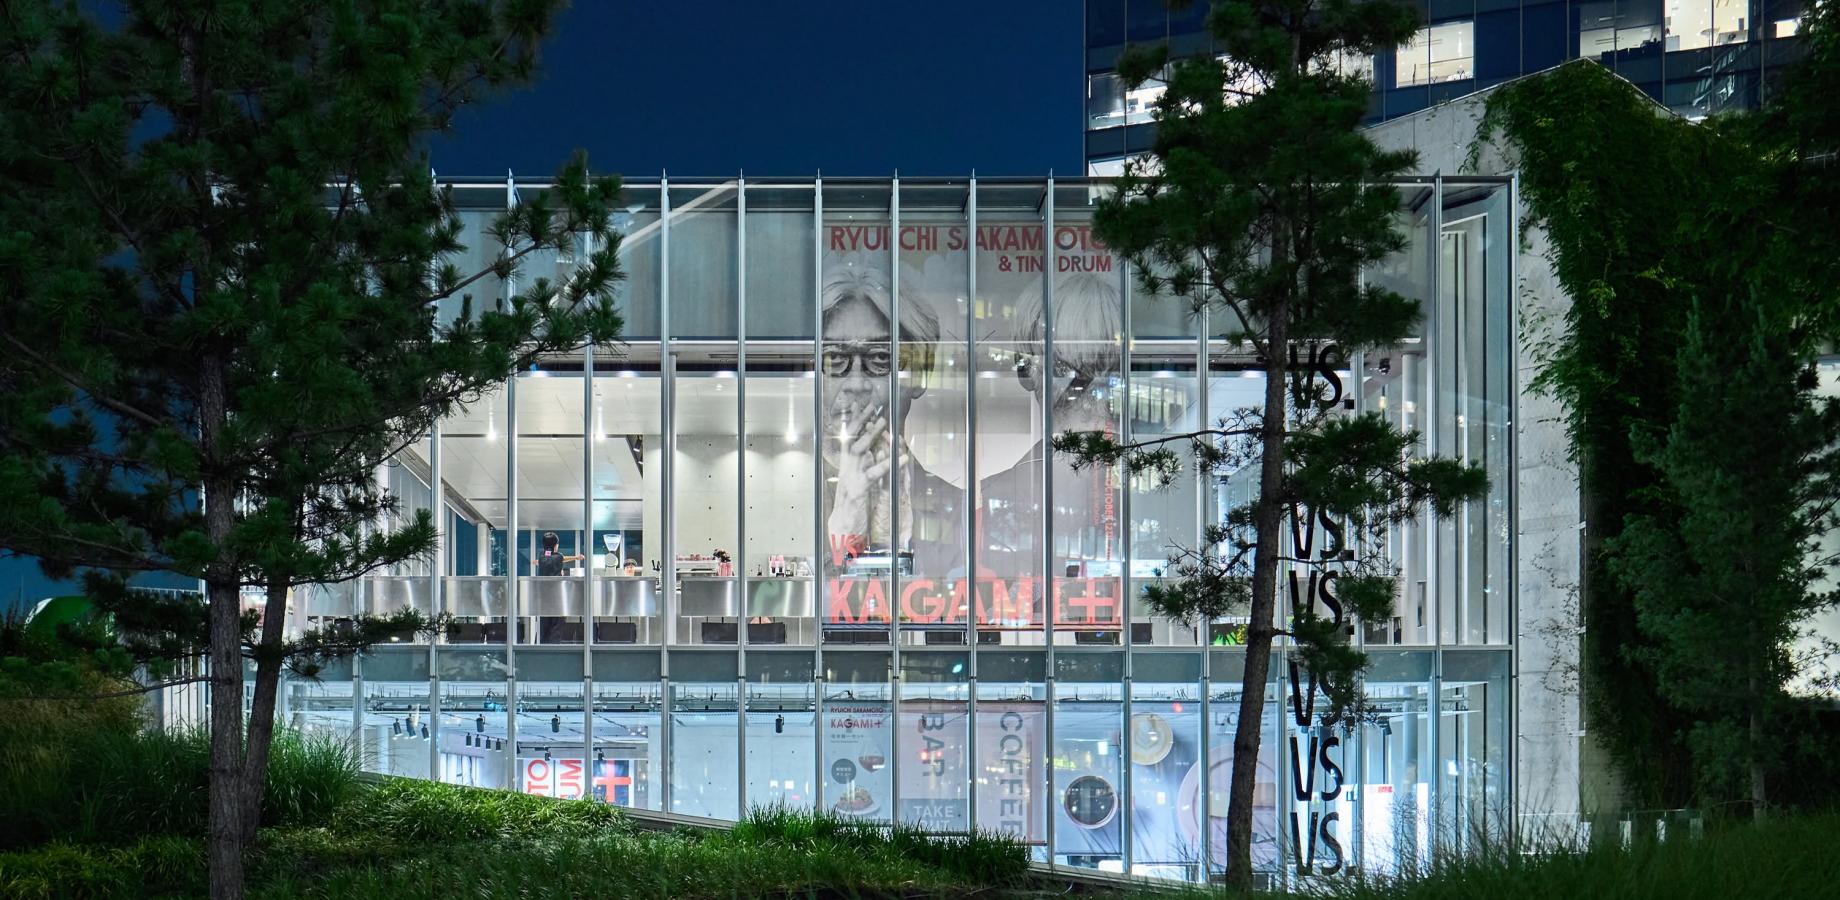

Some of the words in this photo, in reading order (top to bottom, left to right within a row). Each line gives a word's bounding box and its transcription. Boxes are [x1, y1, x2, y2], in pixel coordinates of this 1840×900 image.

[830, 227, 937, 250] RYUICHI
[998, 256, 1011, 272] &
[1016, 256, 1044, 272] TIN
[1058, 256, 1112, 272] DRUM
[999, 712, 1023, 838] COFFEE
[913, 805, 954, 818] TAKE
